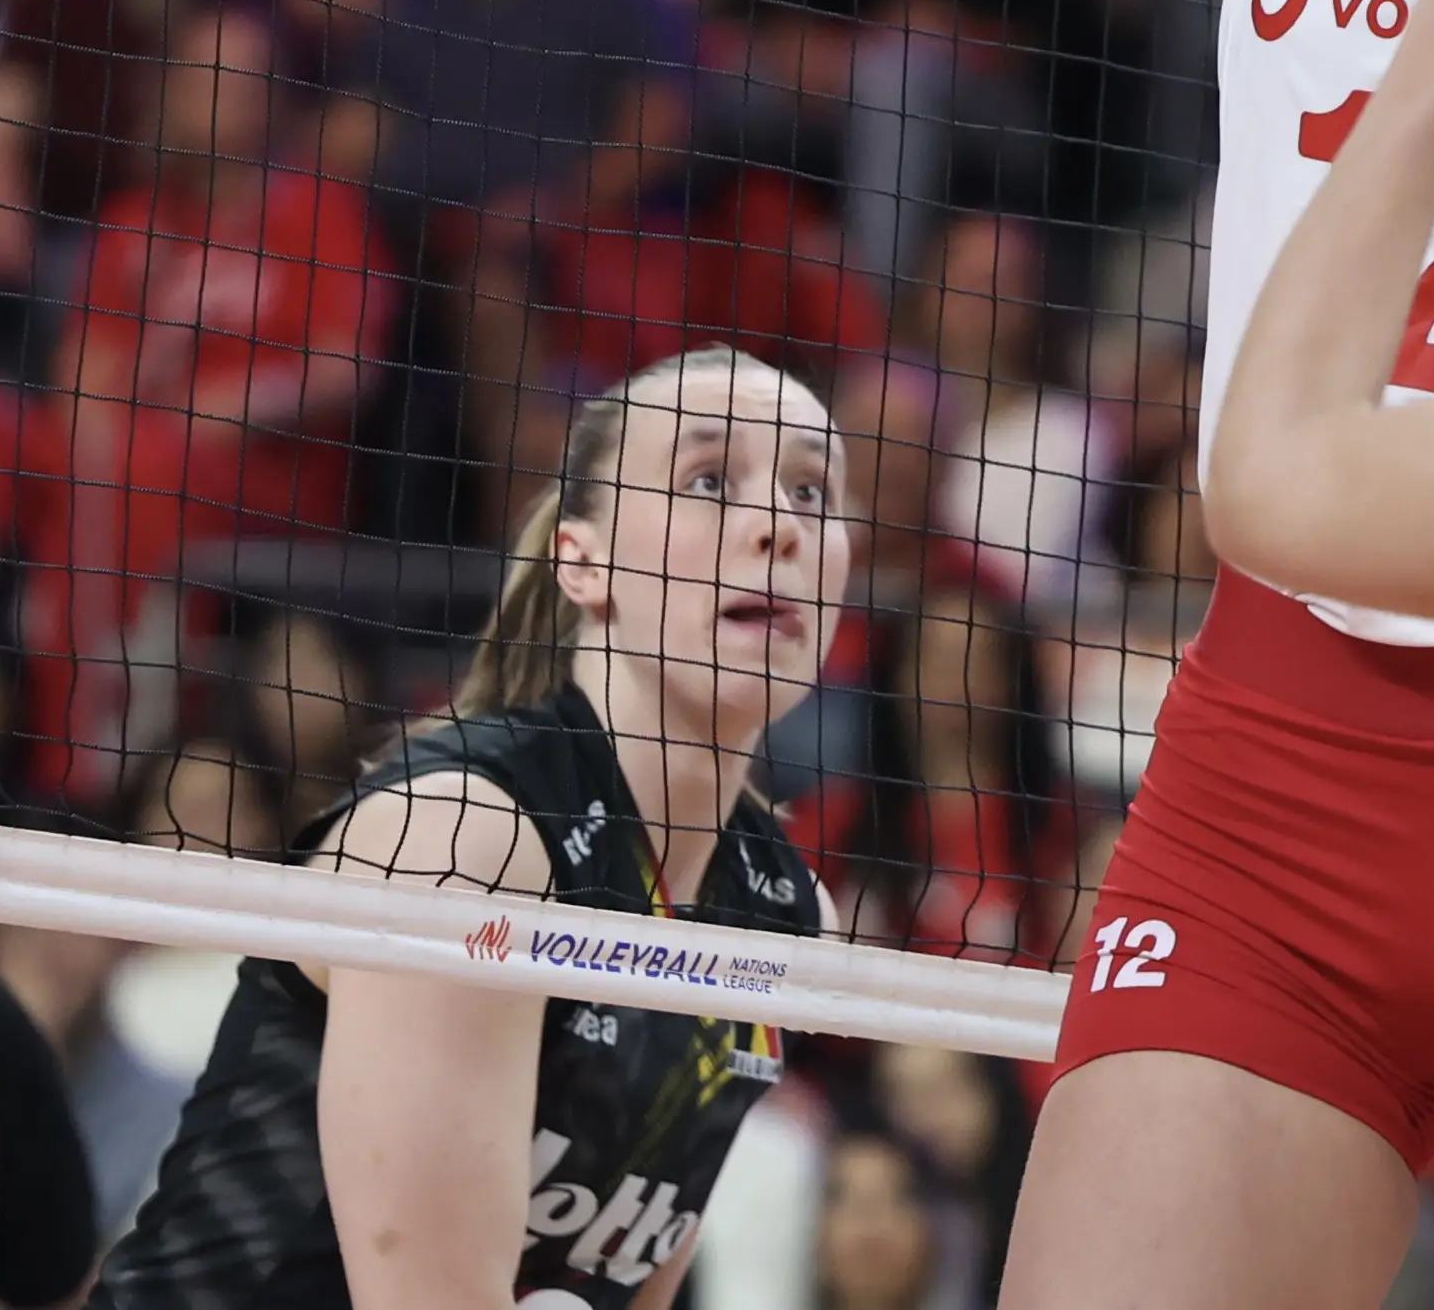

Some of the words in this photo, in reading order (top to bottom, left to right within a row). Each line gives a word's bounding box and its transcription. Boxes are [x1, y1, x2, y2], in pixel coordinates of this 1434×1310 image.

[530, 930, 721, 987] VOLLEYBALL
[729, 957, 787, 978] NATIONS
[1090, 916, 1177, 992] 12
[722, 974, 773, 994] LEAGUE
